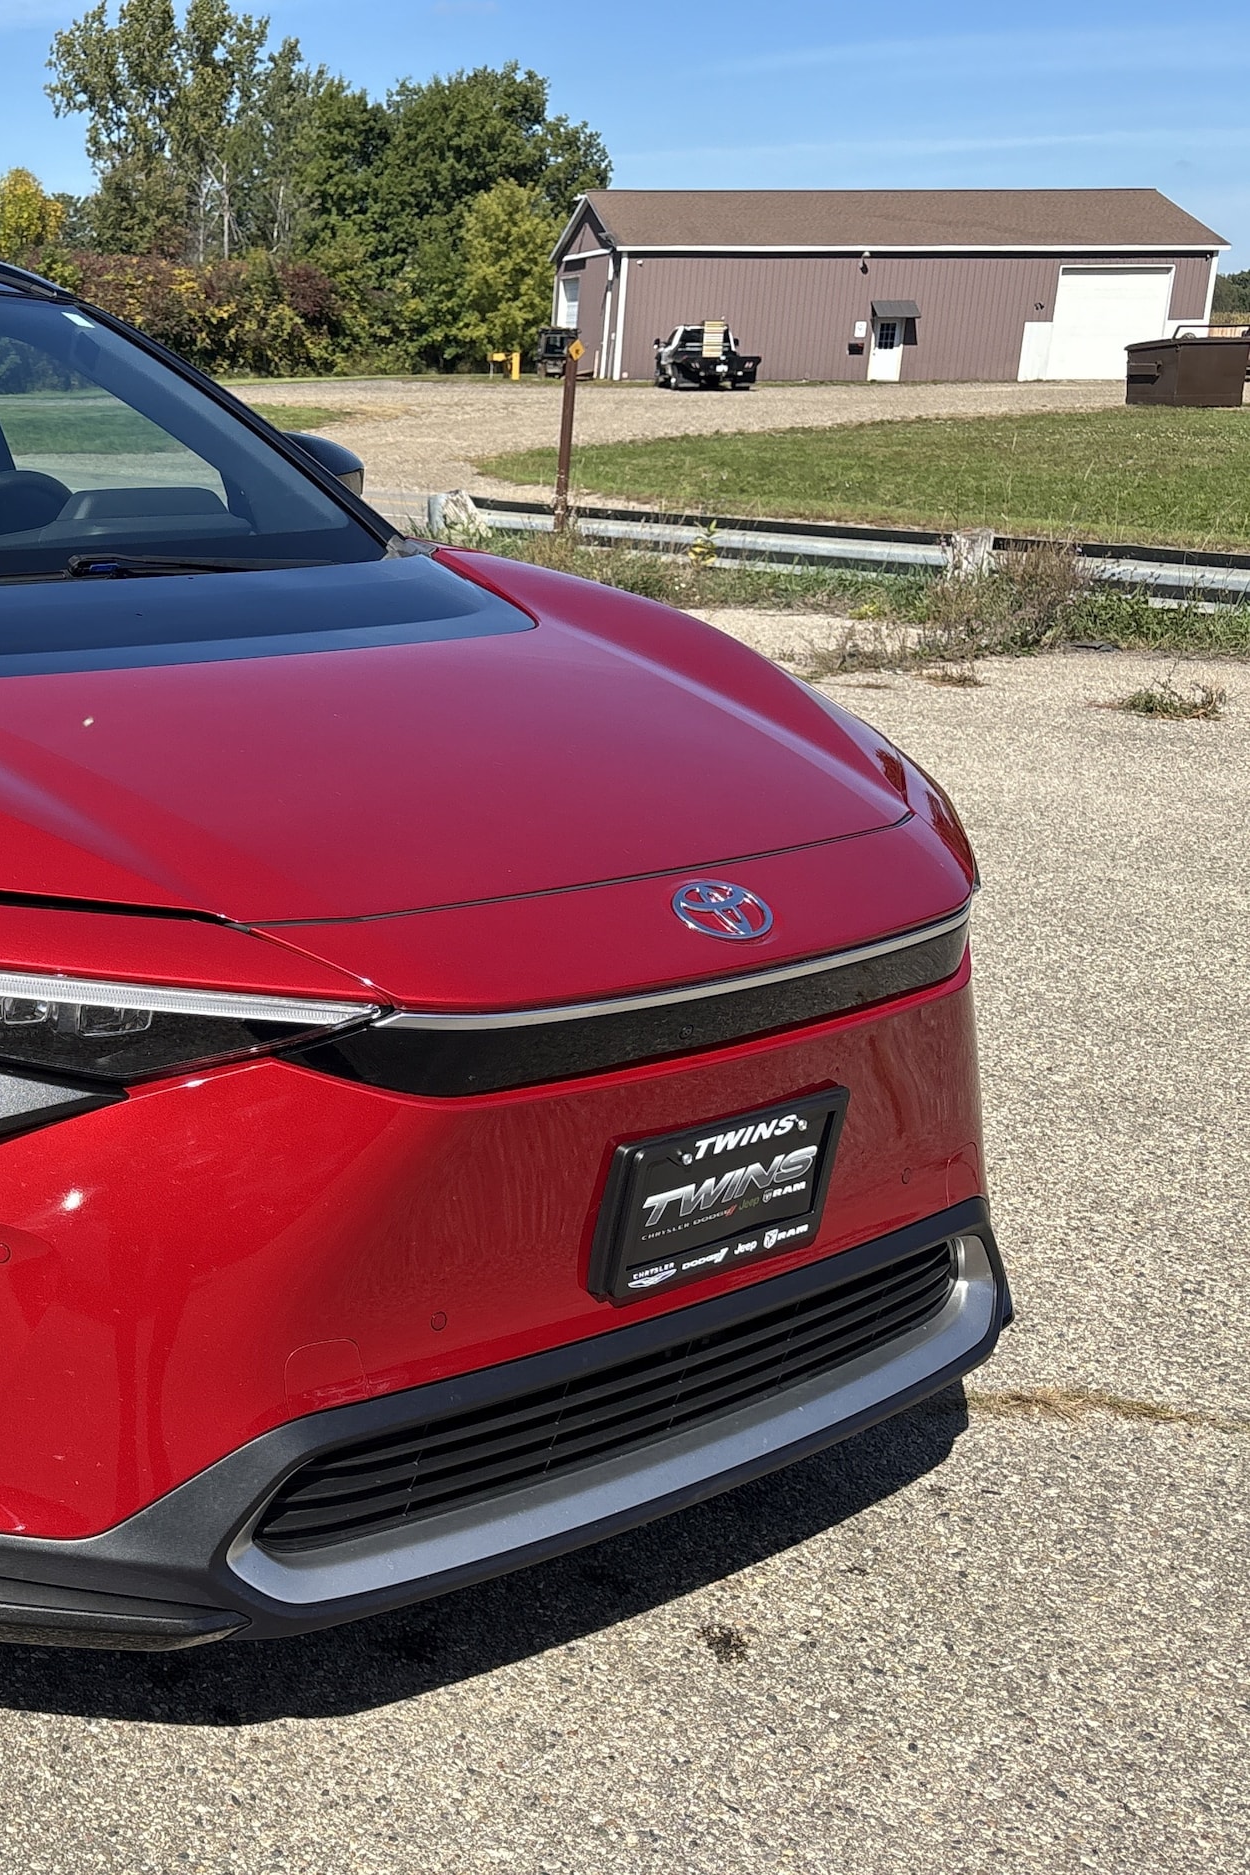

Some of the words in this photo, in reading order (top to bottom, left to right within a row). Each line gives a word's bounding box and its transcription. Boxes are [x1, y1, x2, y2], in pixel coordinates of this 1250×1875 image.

[694, 1113, 798, 1161] TWINS
[641, 1145, 818, 1228] TWINS
[641, 1222, 690, 1241] CHRYSLER
[739, 1196, 760, 1211] Jeep
[772, 1181, 806, 1199] RAM
[632, 1262, 675, 1280] CHRYSLER
[733, 1240, 758, 1255] Jeep
[777, 1224, 808, 1241] RAM
